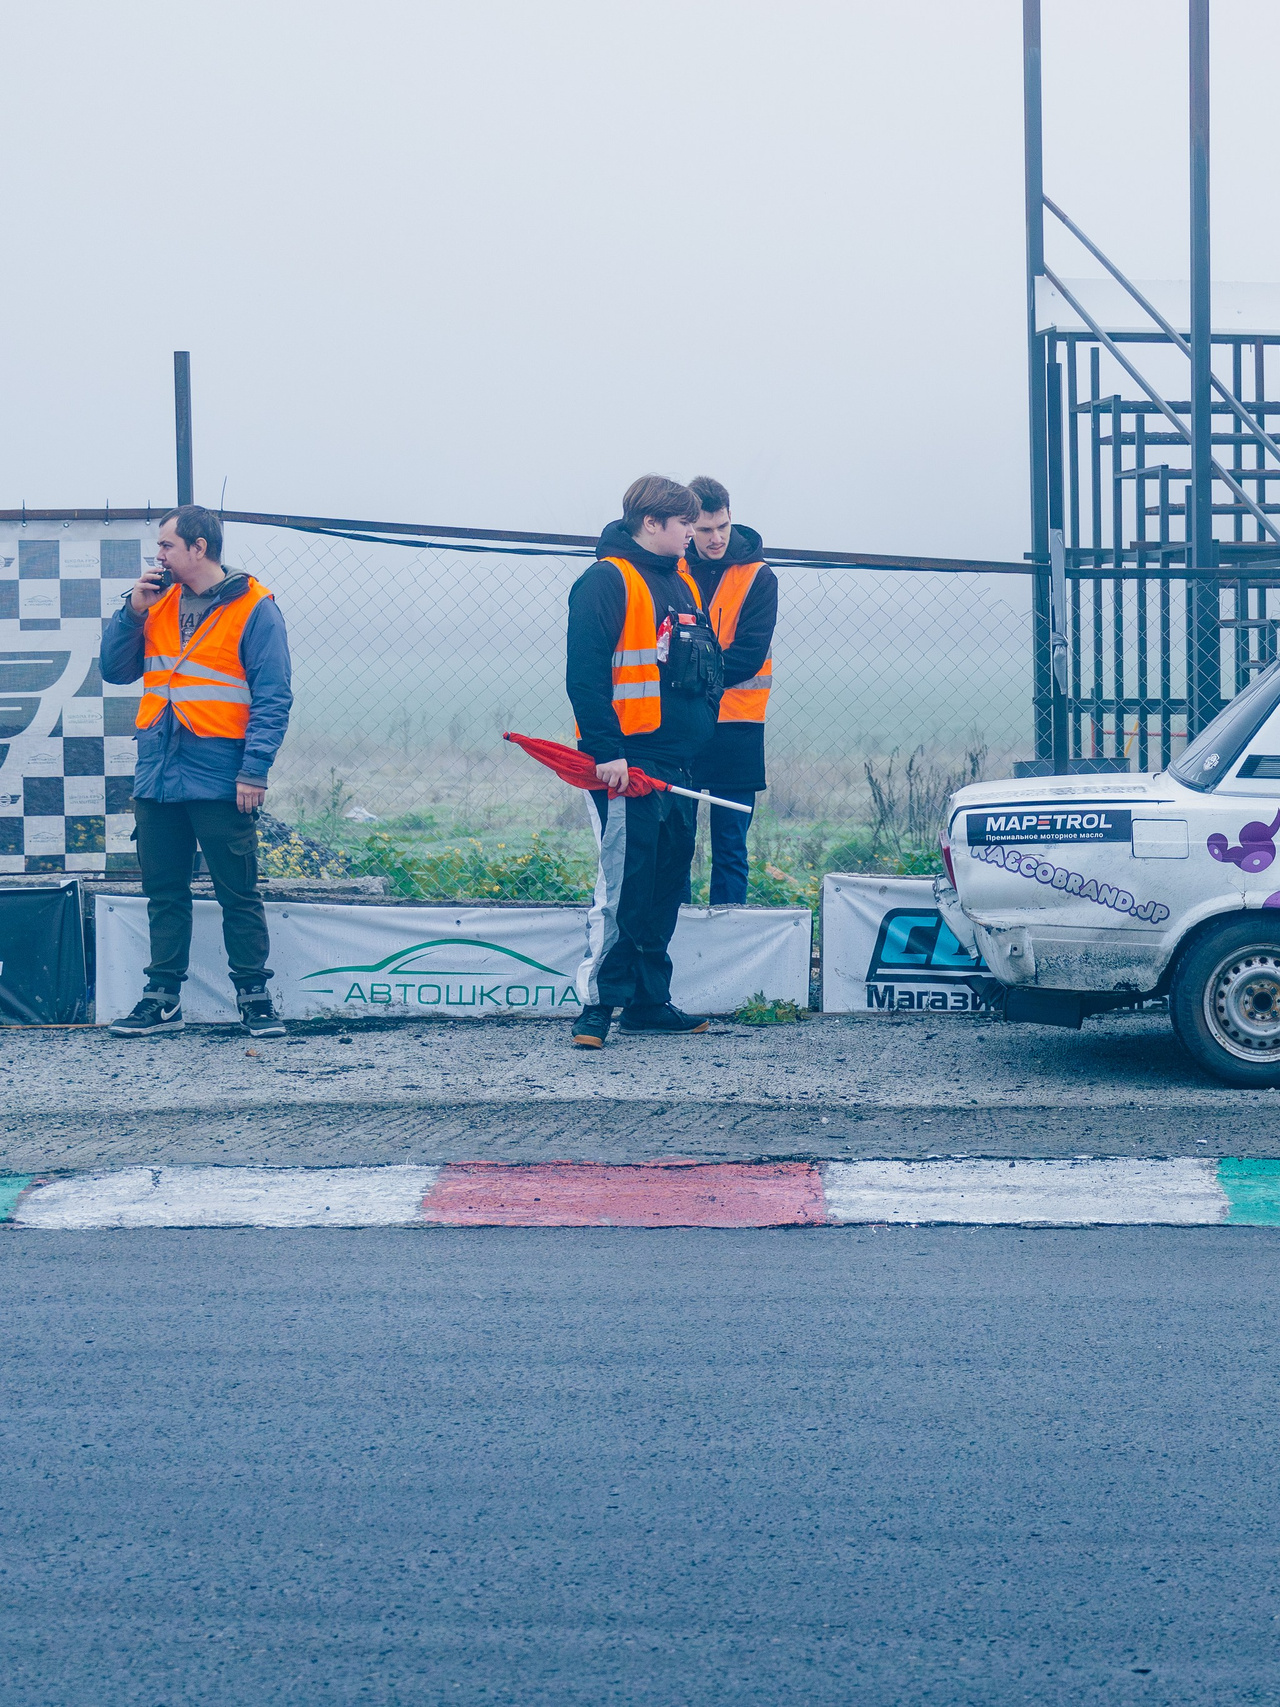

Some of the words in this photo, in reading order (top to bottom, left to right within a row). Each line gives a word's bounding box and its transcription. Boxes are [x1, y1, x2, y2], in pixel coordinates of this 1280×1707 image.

[986, 813, 1113, 832] MAPETROL
[985, 834, 1038, 842] Премиальное
[1040, 833, 1078, 841] моторное
[343, 982, 583, 1007] АВТОШКОЛА
